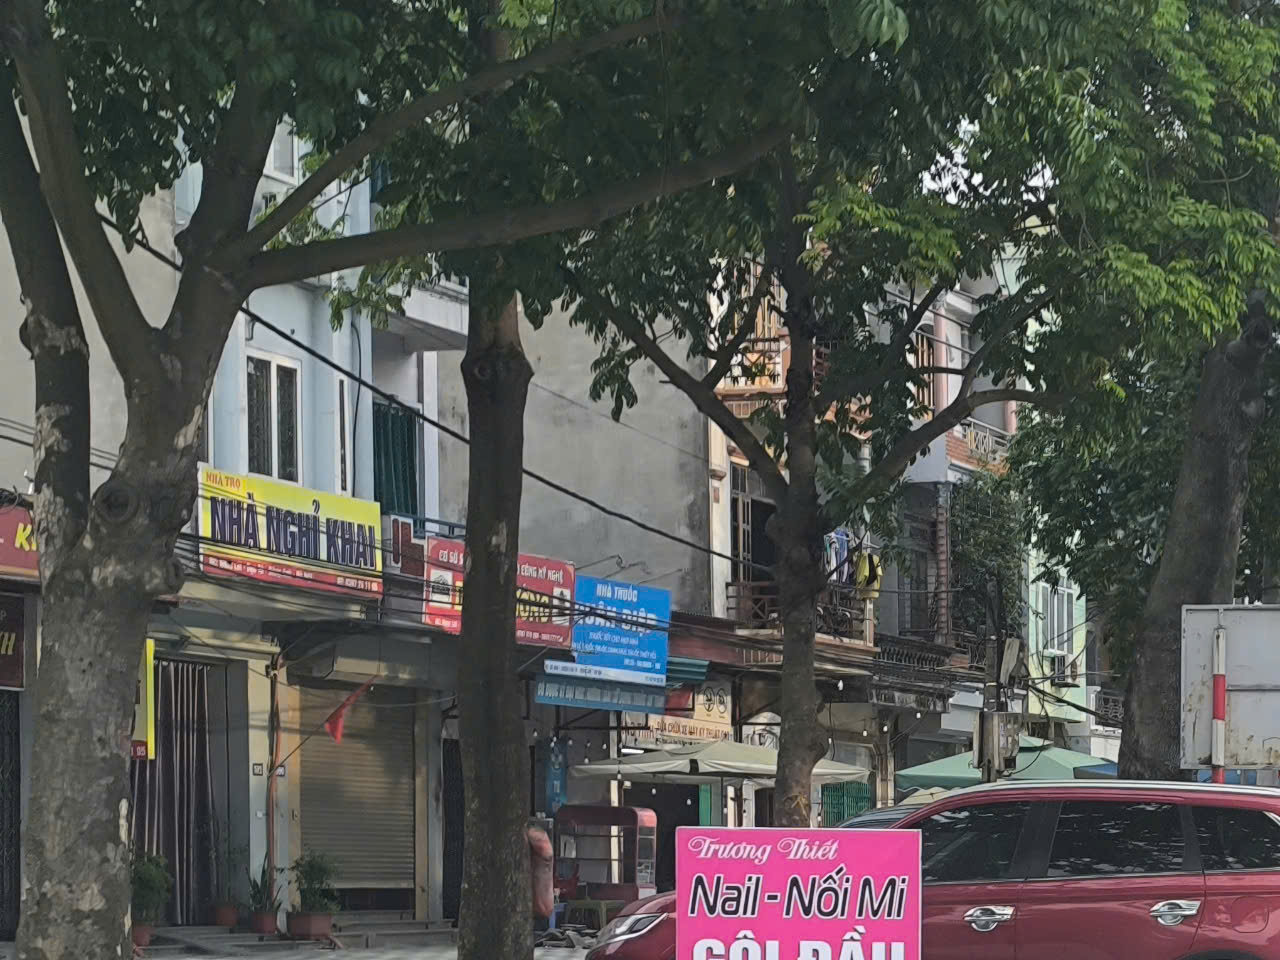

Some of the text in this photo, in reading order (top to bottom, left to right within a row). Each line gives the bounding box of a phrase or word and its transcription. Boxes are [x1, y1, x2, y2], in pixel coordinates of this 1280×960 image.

[206, 472, 241, 491] NHÀ TRỌ
[210, 491, 260, 550] NHÀ
[266, 499, 321, 560] NGHỈ
[326, 517, 377, 569] KHAI
[596, 583, 638, 603] NHÀ THUỐC
[688, 836, 839, 865] Trương Thiết
[688, 873, 762, 918] Nail
[783, 864, 852, 919] Nối
[856, 875, 908, 919] Mi
